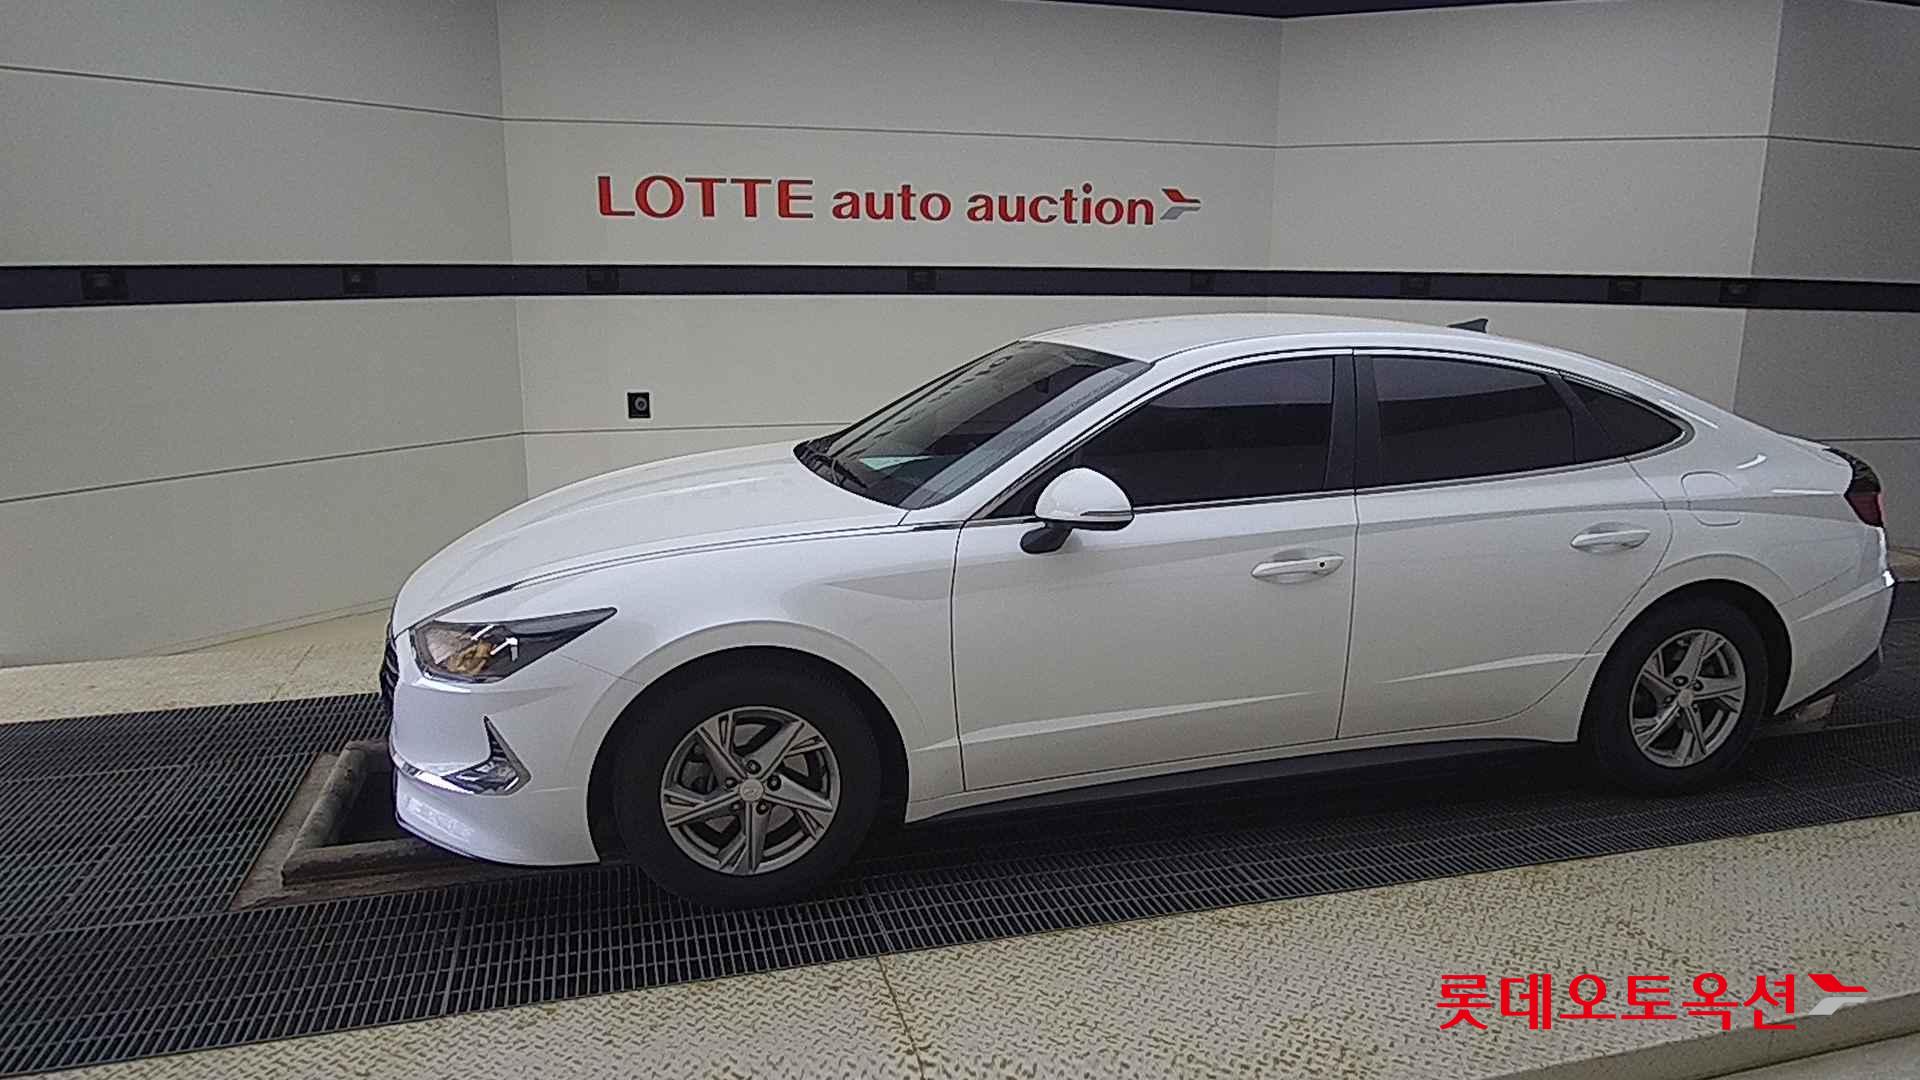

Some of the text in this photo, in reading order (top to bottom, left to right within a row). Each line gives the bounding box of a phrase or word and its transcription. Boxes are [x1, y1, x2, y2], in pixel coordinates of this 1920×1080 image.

[597, 175, 1155, 226] LOTTE auto auction
